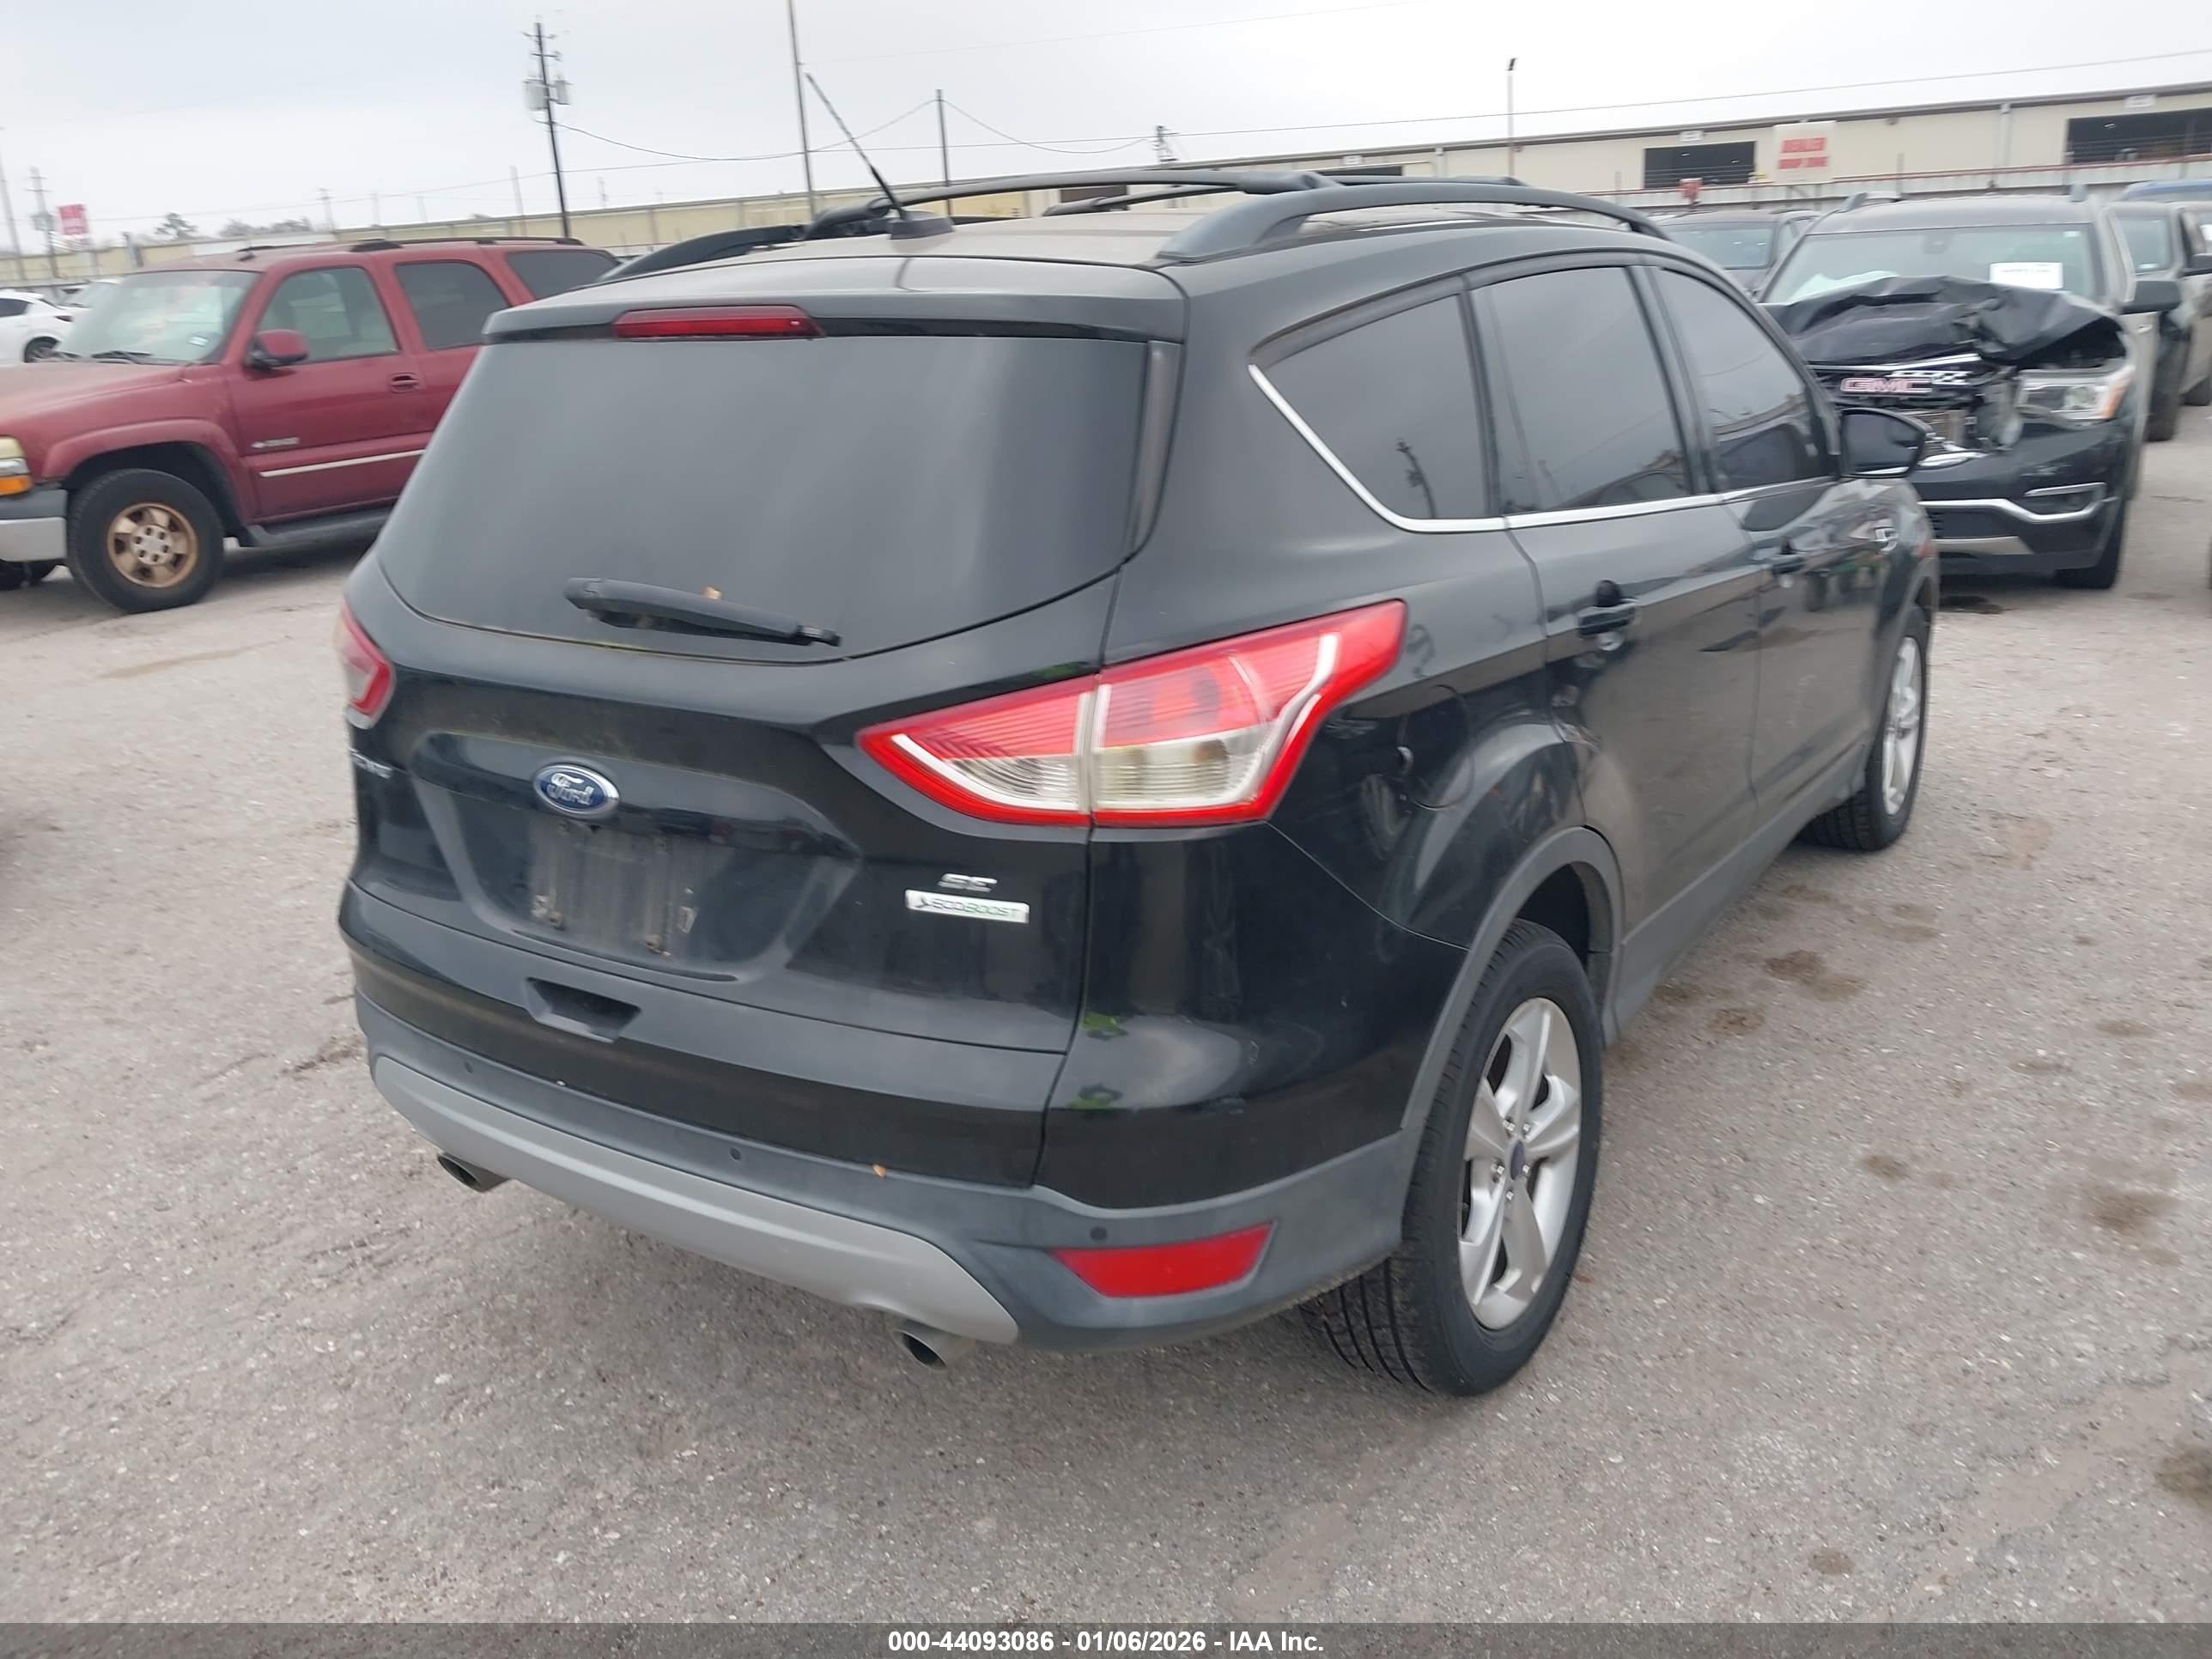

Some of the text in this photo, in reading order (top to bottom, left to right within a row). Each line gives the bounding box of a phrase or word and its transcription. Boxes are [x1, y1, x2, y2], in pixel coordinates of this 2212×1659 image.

[1840, 377, 1932, 393] GMC
[546, 773, 595, 805] Ford
[937, 872, 998, 892] SE
[932, 898, 1020, 918] ECOBOOST
